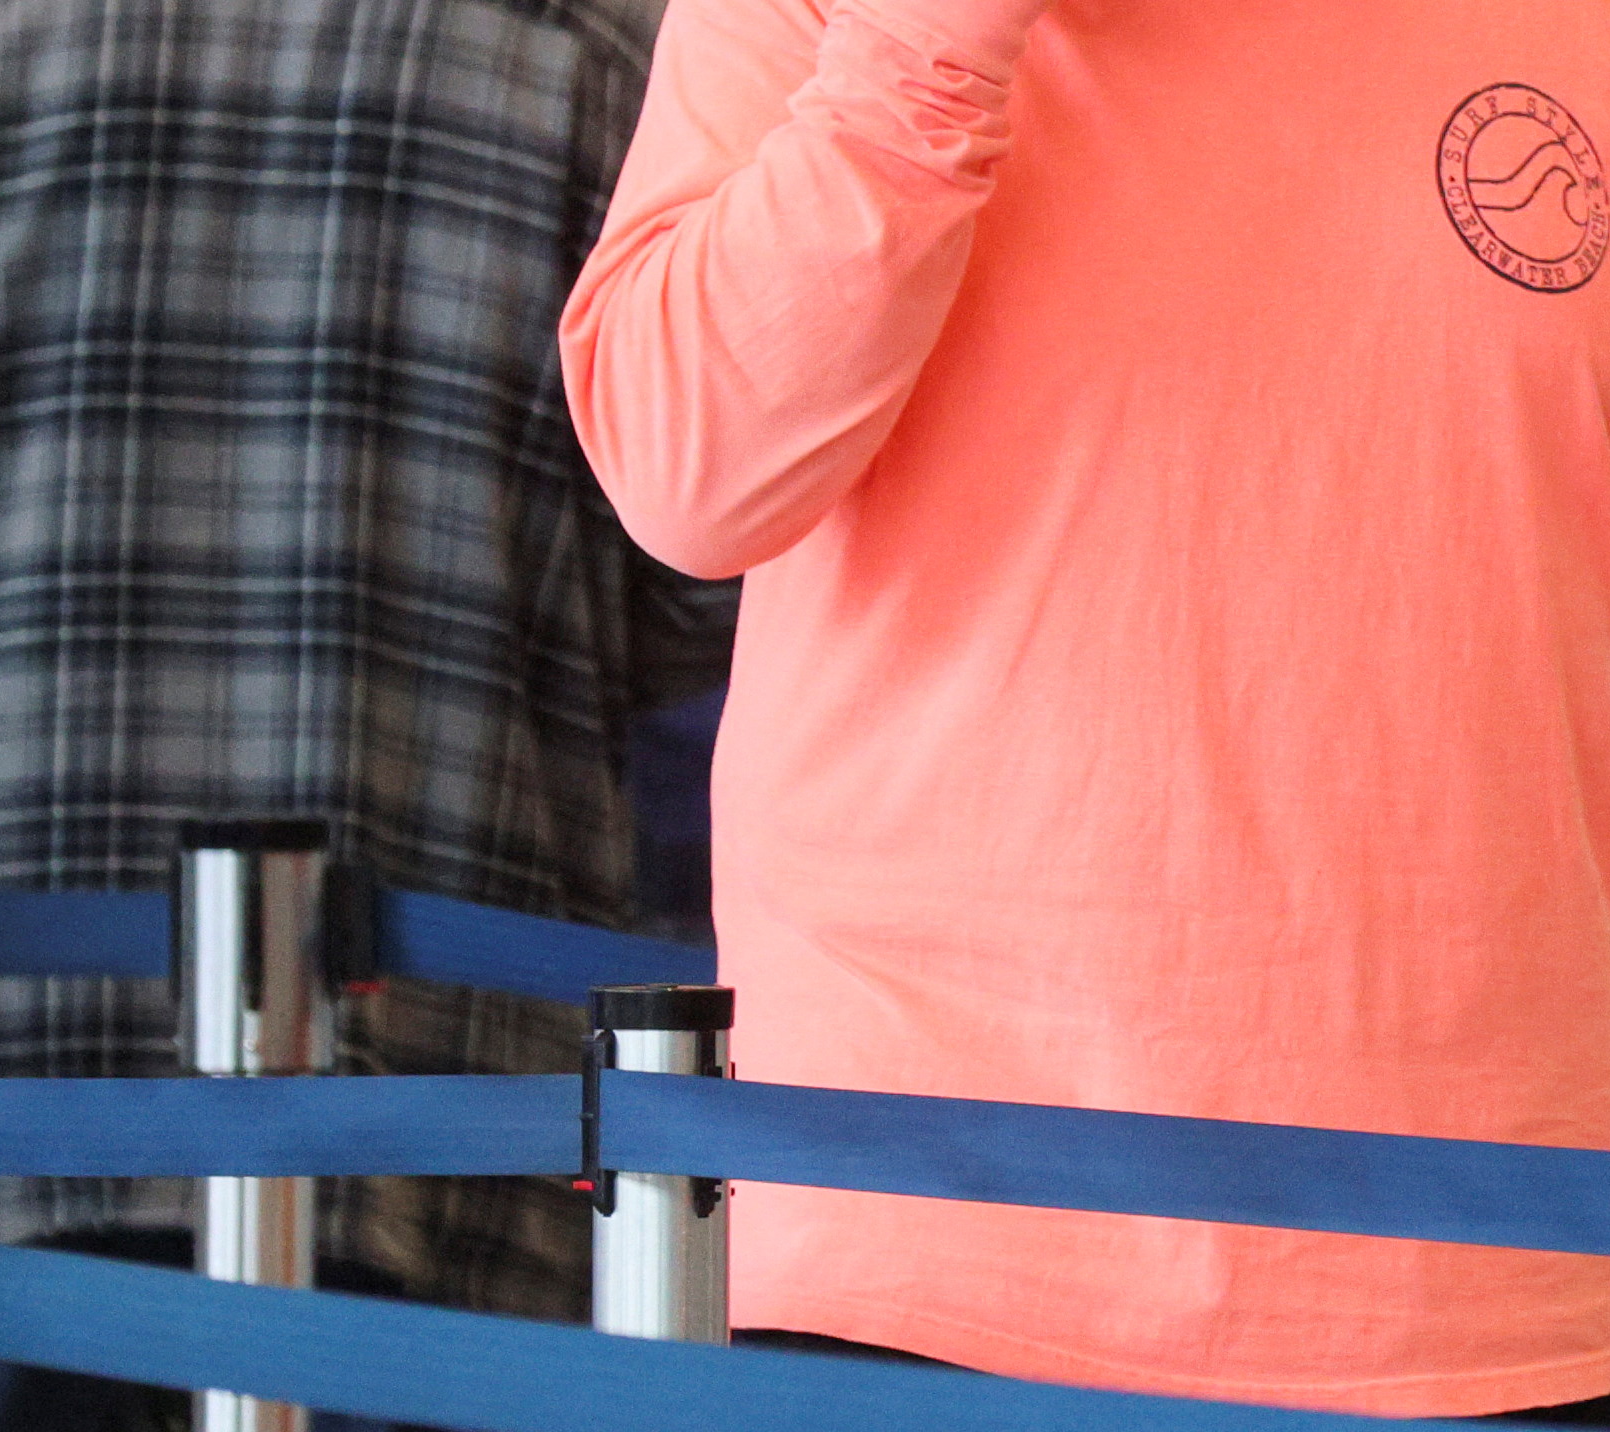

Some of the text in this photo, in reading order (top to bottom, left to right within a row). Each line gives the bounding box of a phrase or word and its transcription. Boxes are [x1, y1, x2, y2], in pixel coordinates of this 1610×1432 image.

[1443, 95, 1601, 189] SURF STYLE
[1447, 186, 1606, 286] CLEARWATER BEACH
